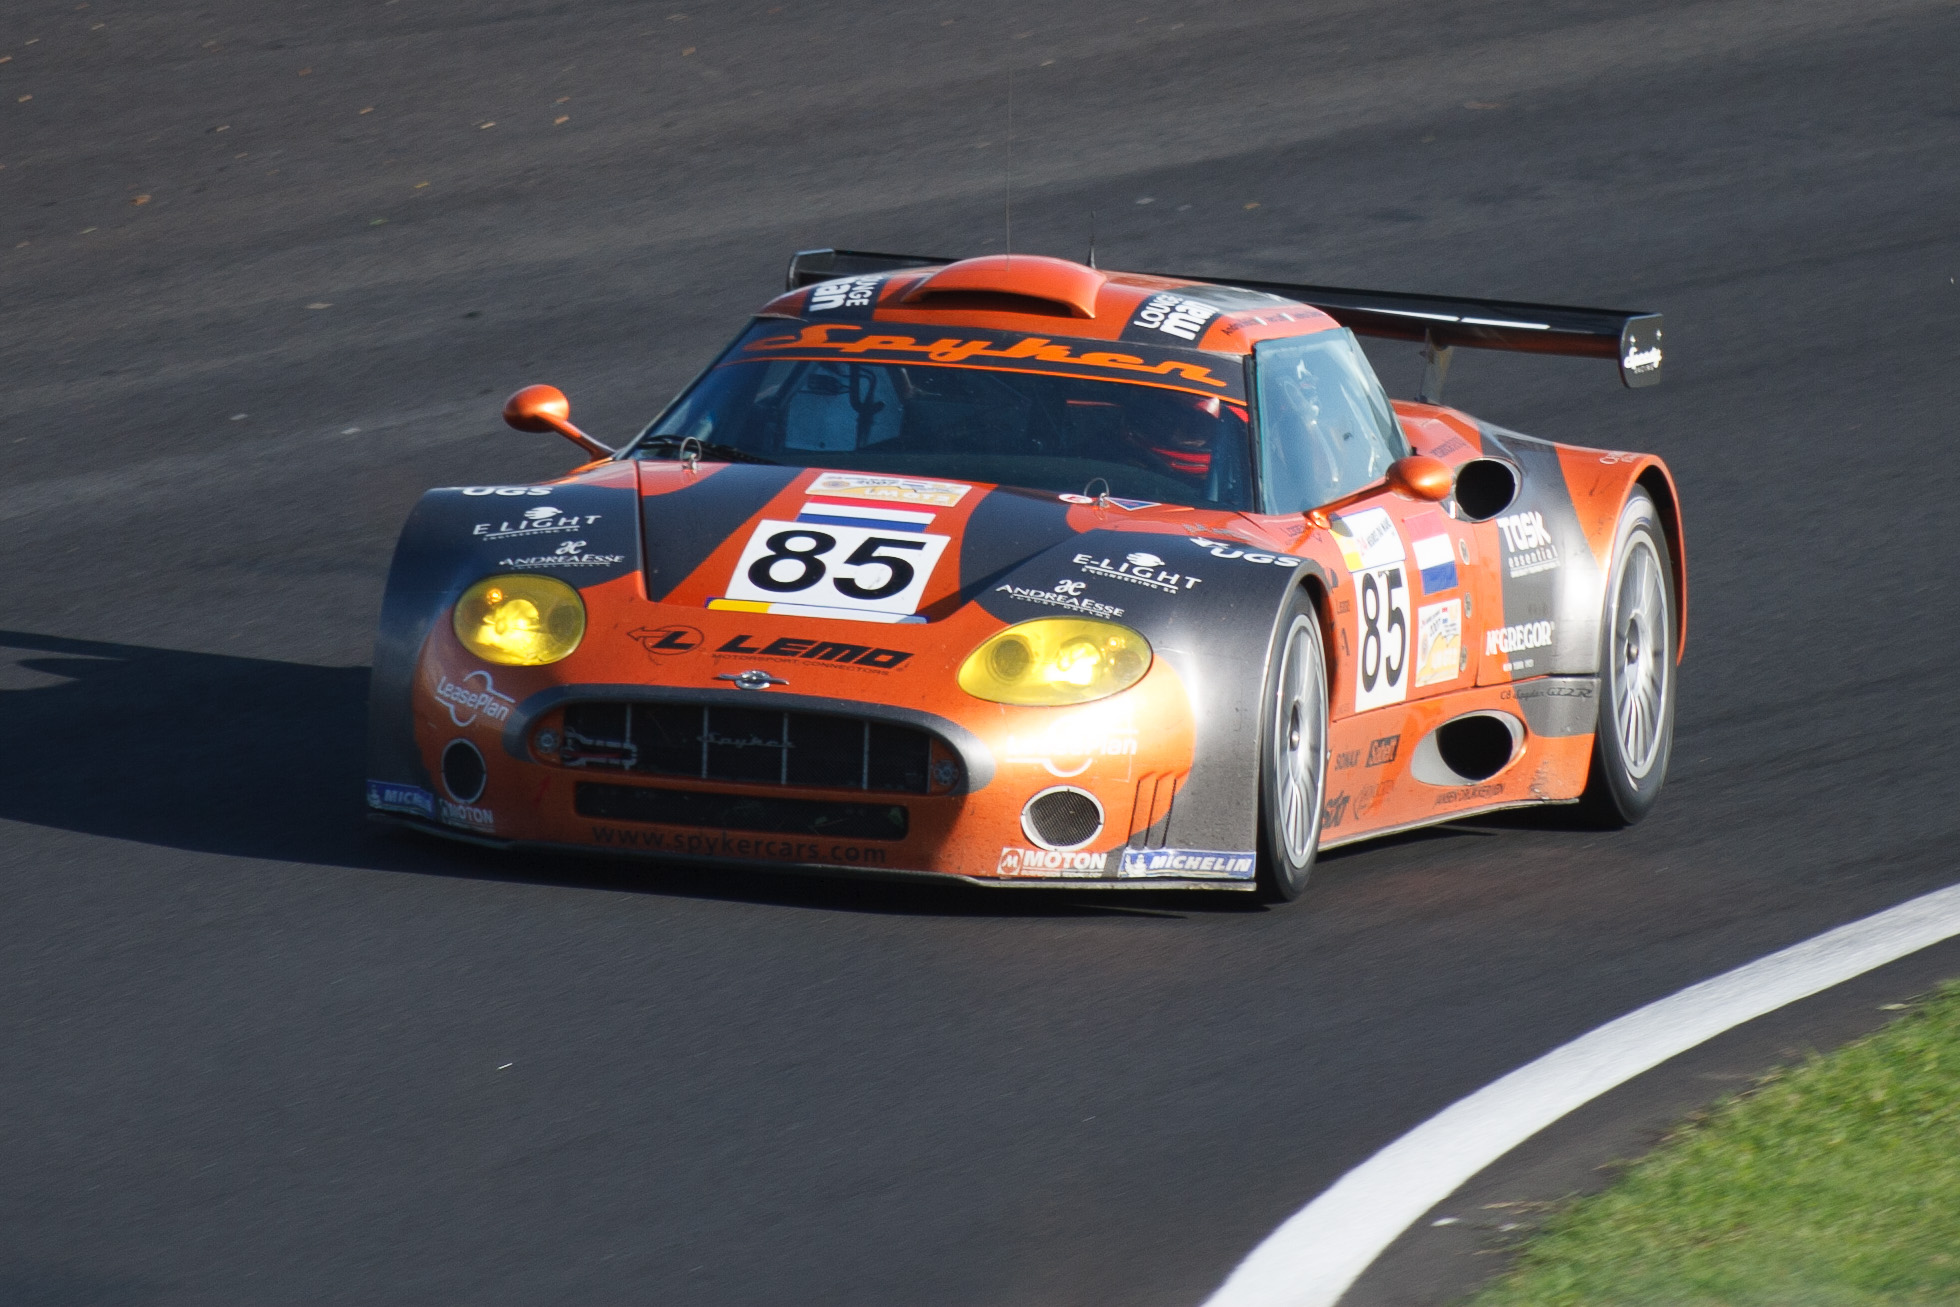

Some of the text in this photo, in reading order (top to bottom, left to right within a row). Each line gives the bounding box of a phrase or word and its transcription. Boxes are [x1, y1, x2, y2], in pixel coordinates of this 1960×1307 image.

[1159, 299, 1221, 341] man
[744, 323, 1227, 387] Spyker
[748, 529, 927, 600] 85
[1073, 553, 1202, 589] E-LIGHT
[1210, 548, 1302, 568] UGS
[1362, 568, 1407, 694] 85
[712, 653, 890, 676] MOTORSPORT CONNECTORS
[716, 635, 915, 669] LEMO
[436, 676, 510, 721] LeasePlan
[592, 825, 886, 863] www.spykercars.com
[1023, 850, 1107, 870] MOTON
[1149, 852, 1253, 872] MICHELIN
